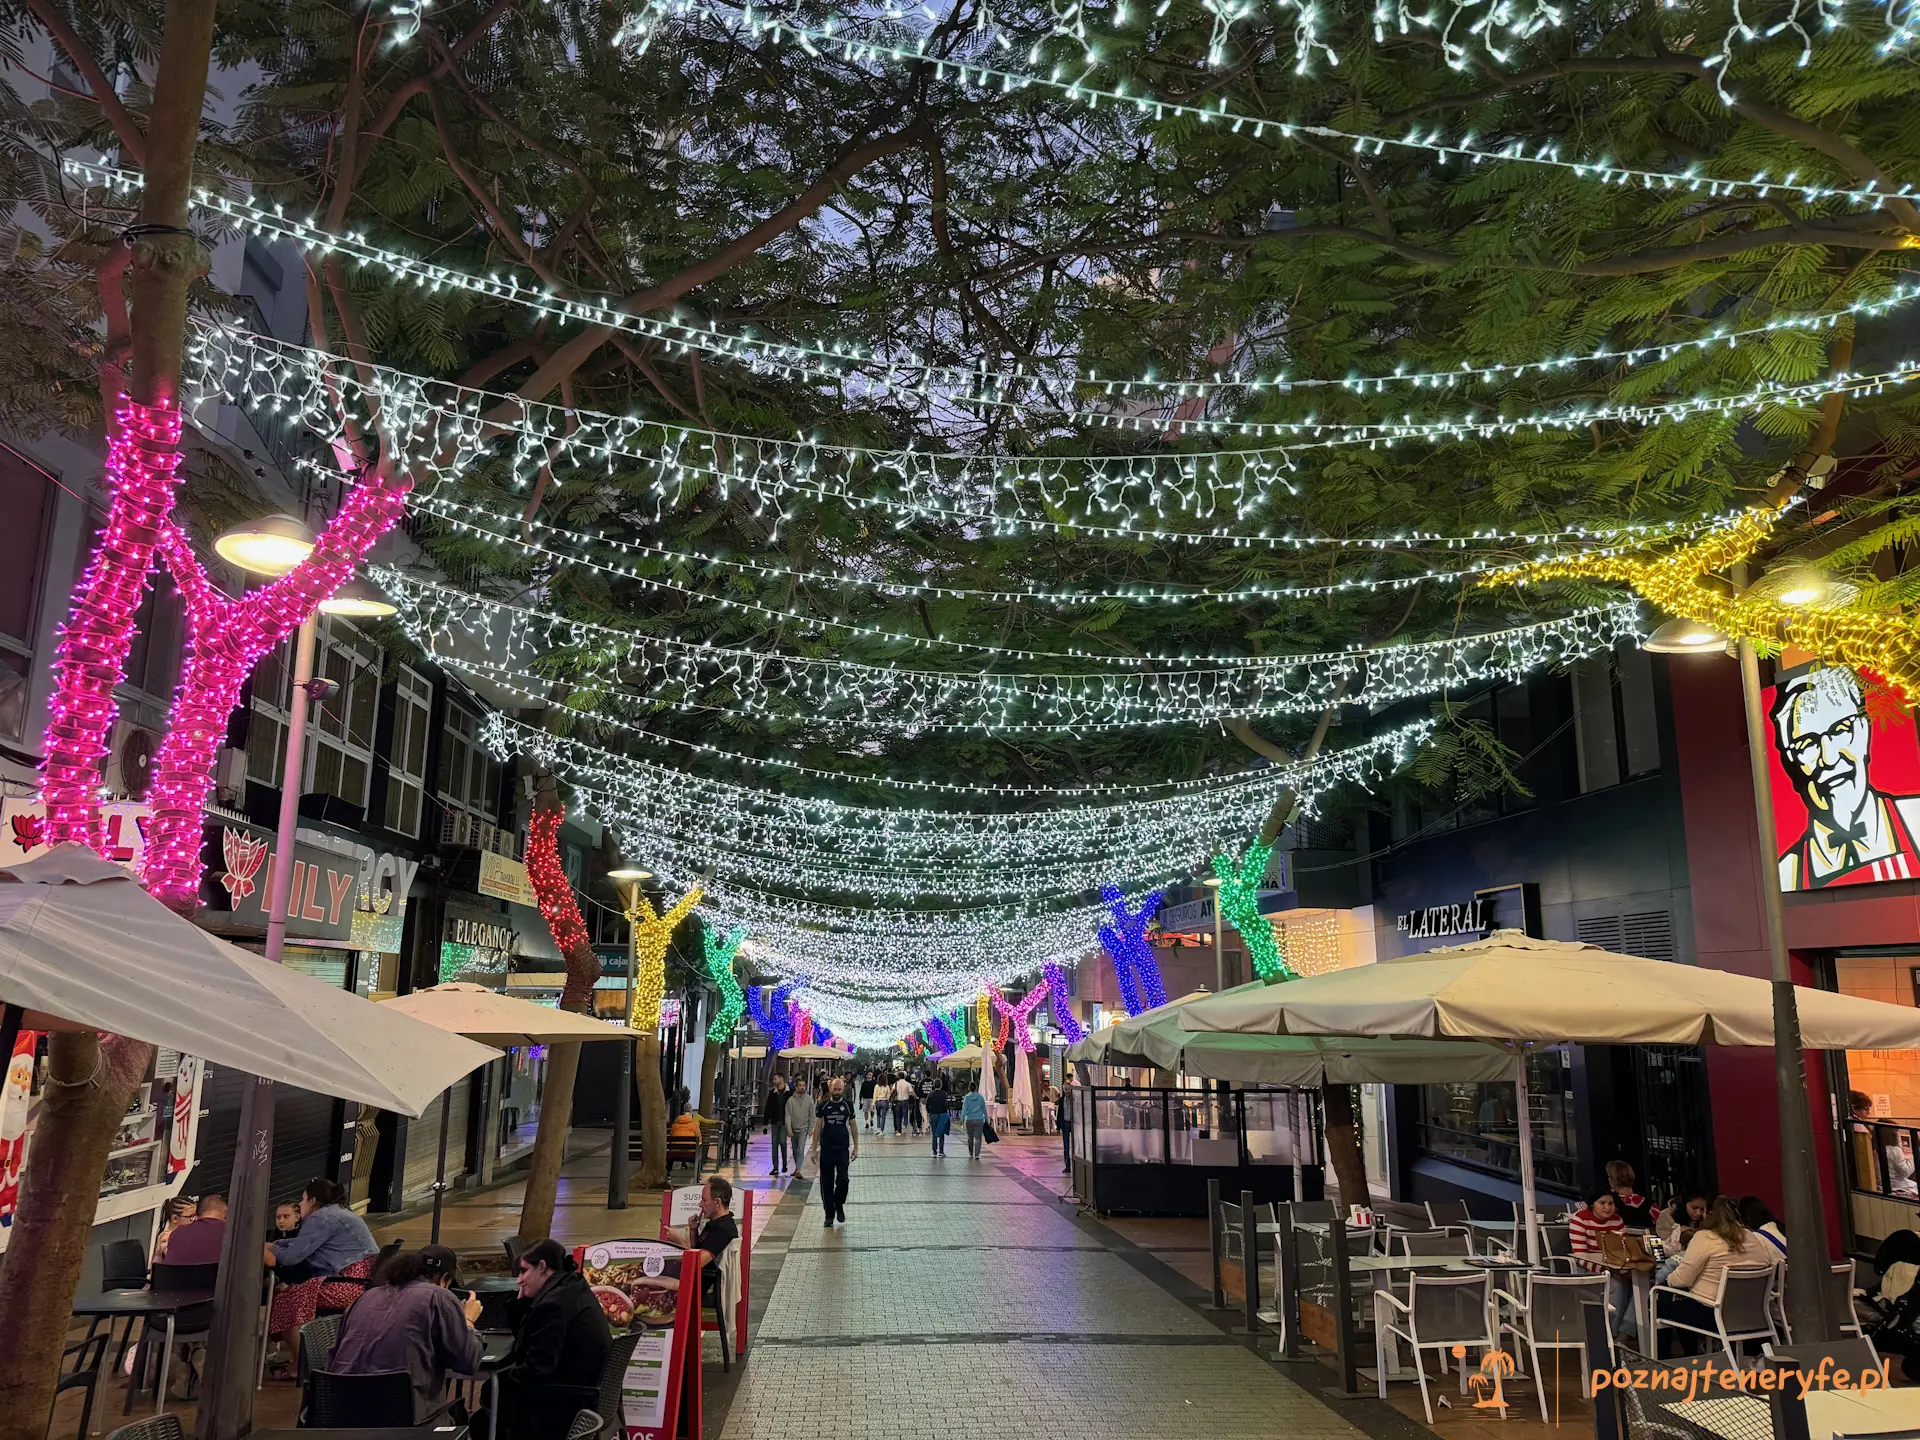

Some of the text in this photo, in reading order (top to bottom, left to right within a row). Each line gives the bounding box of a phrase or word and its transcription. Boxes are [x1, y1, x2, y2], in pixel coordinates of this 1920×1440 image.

[1169, 903, 1197, 924] SEGUROS
[1397, 899, 1487, 938] EL LATERAL
